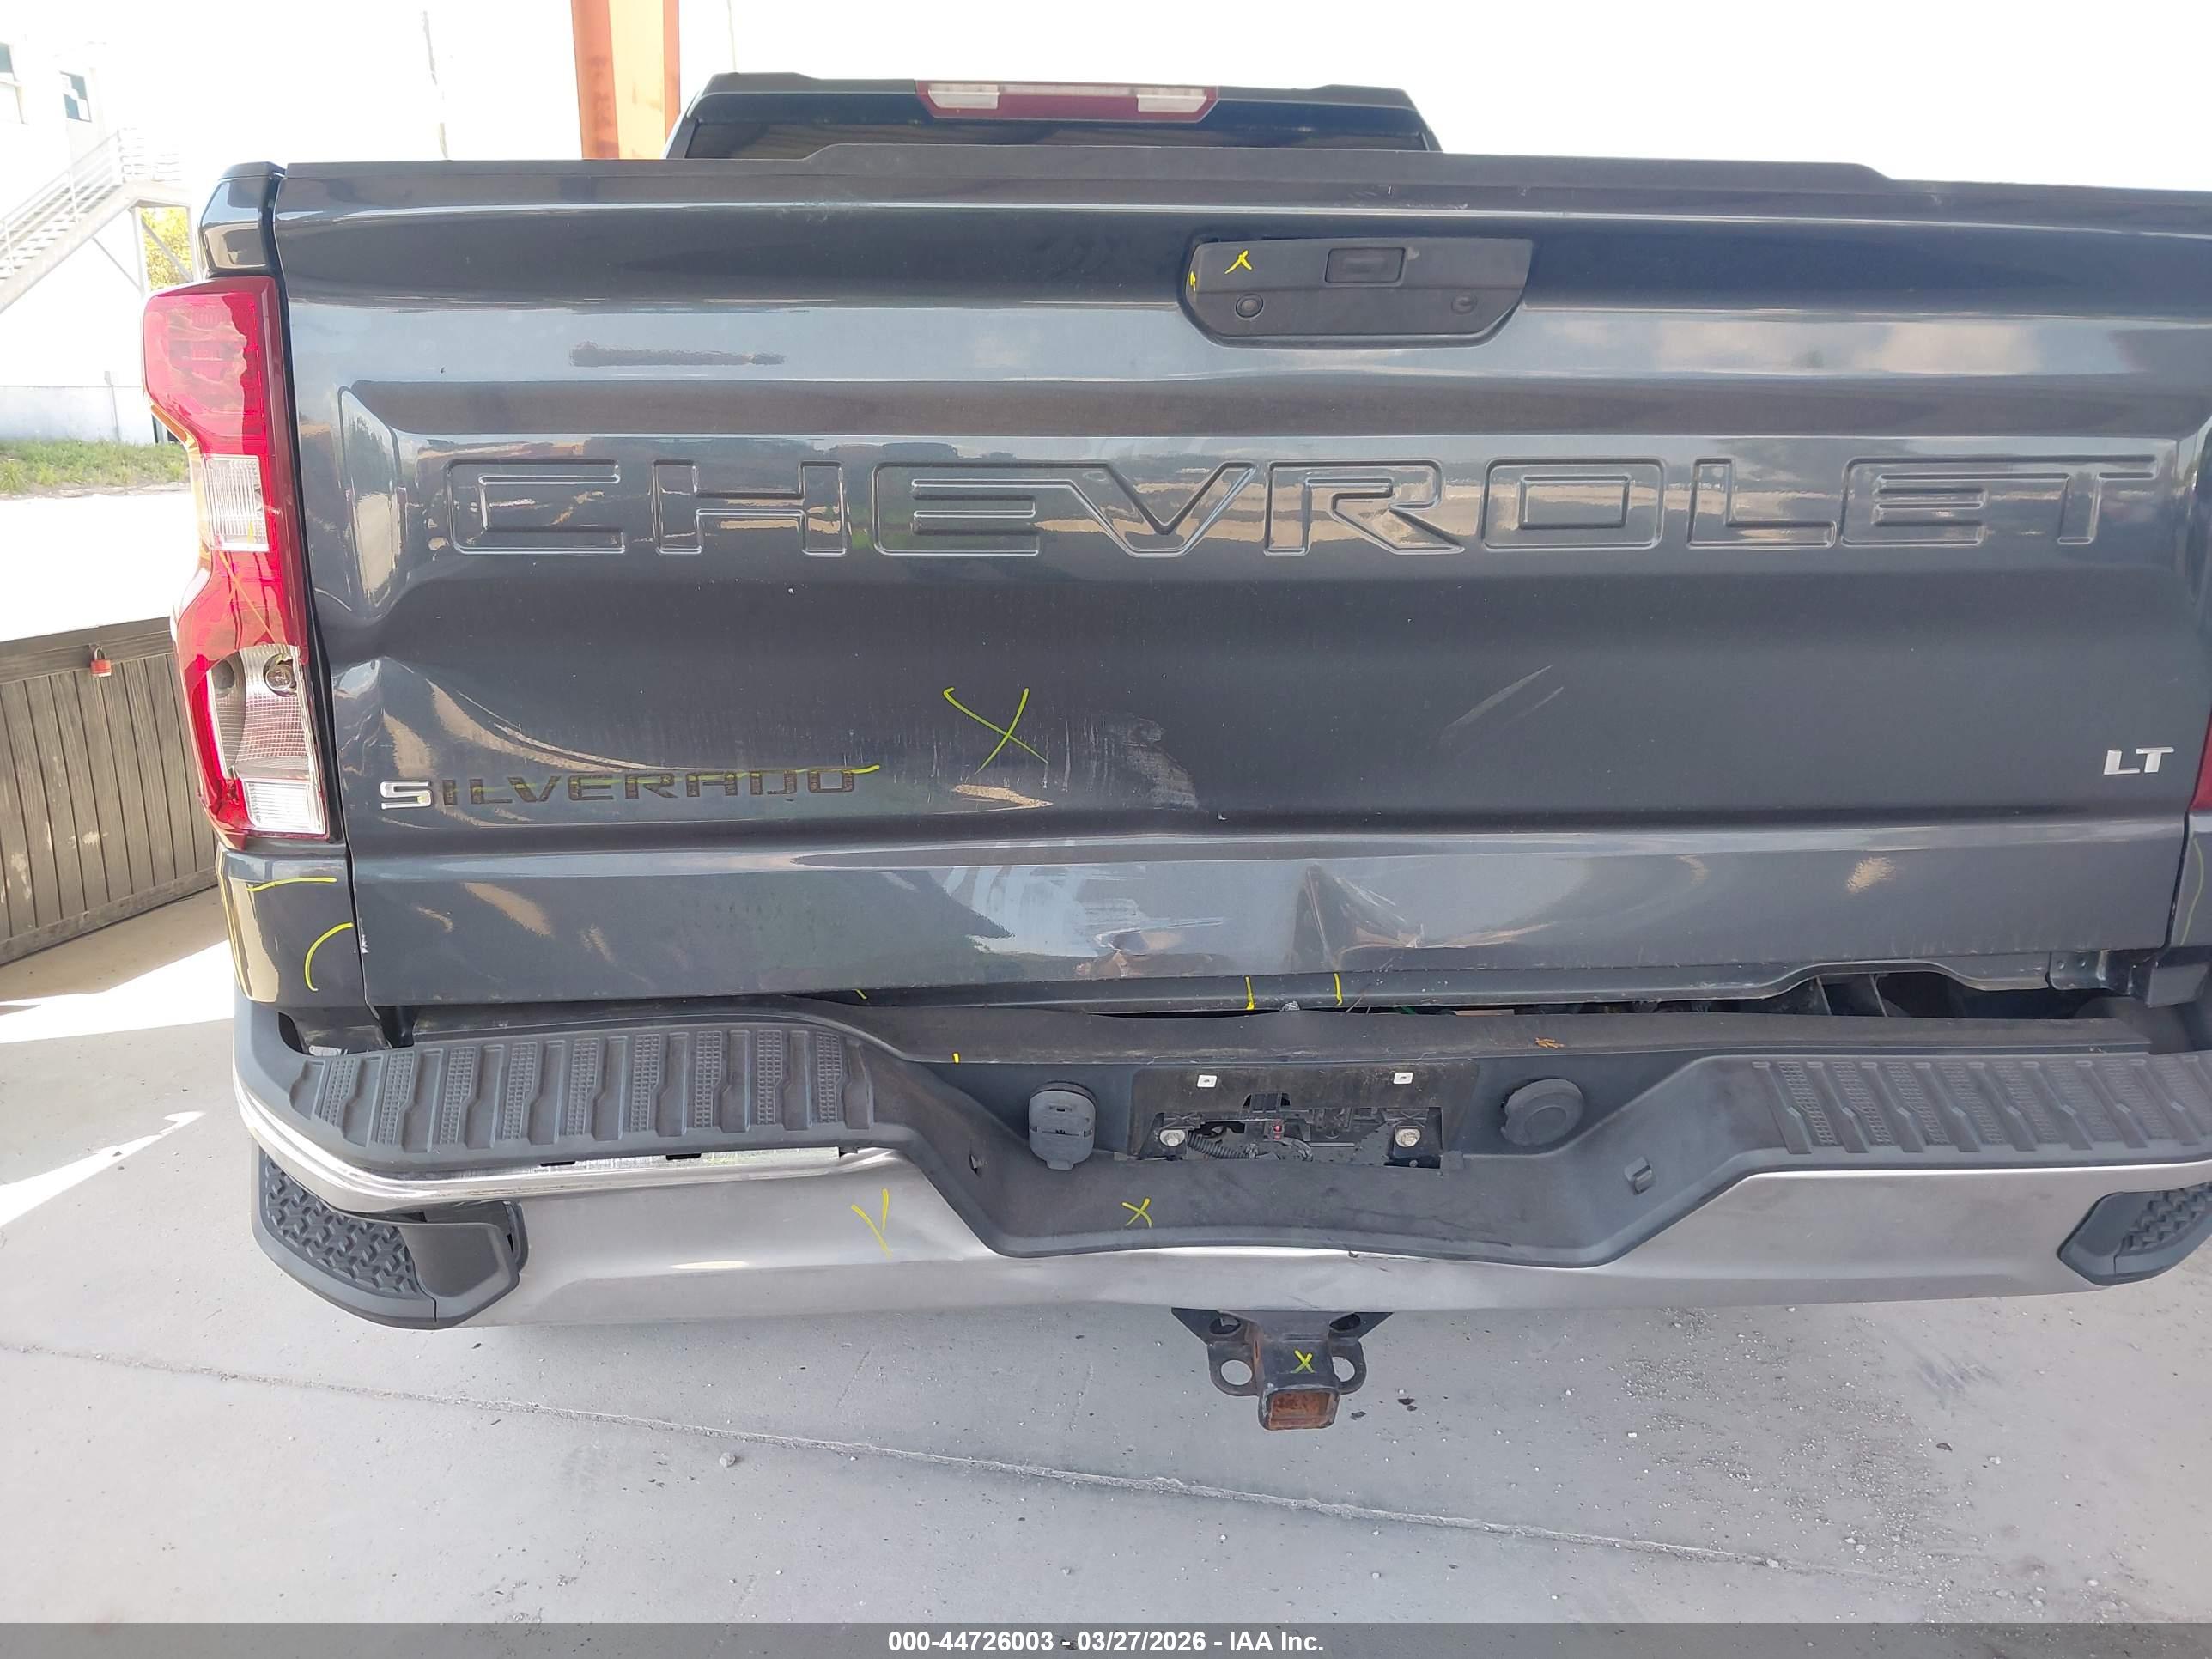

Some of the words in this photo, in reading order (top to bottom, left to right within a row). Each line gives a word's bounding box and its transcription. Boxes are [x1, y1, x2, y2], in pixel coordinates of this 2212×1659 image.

[443, 455, 2159, 560] CHEVROLET
[2103, 746, 2175, 775] LT
[380, 767, 855, 810] SILVERADO
